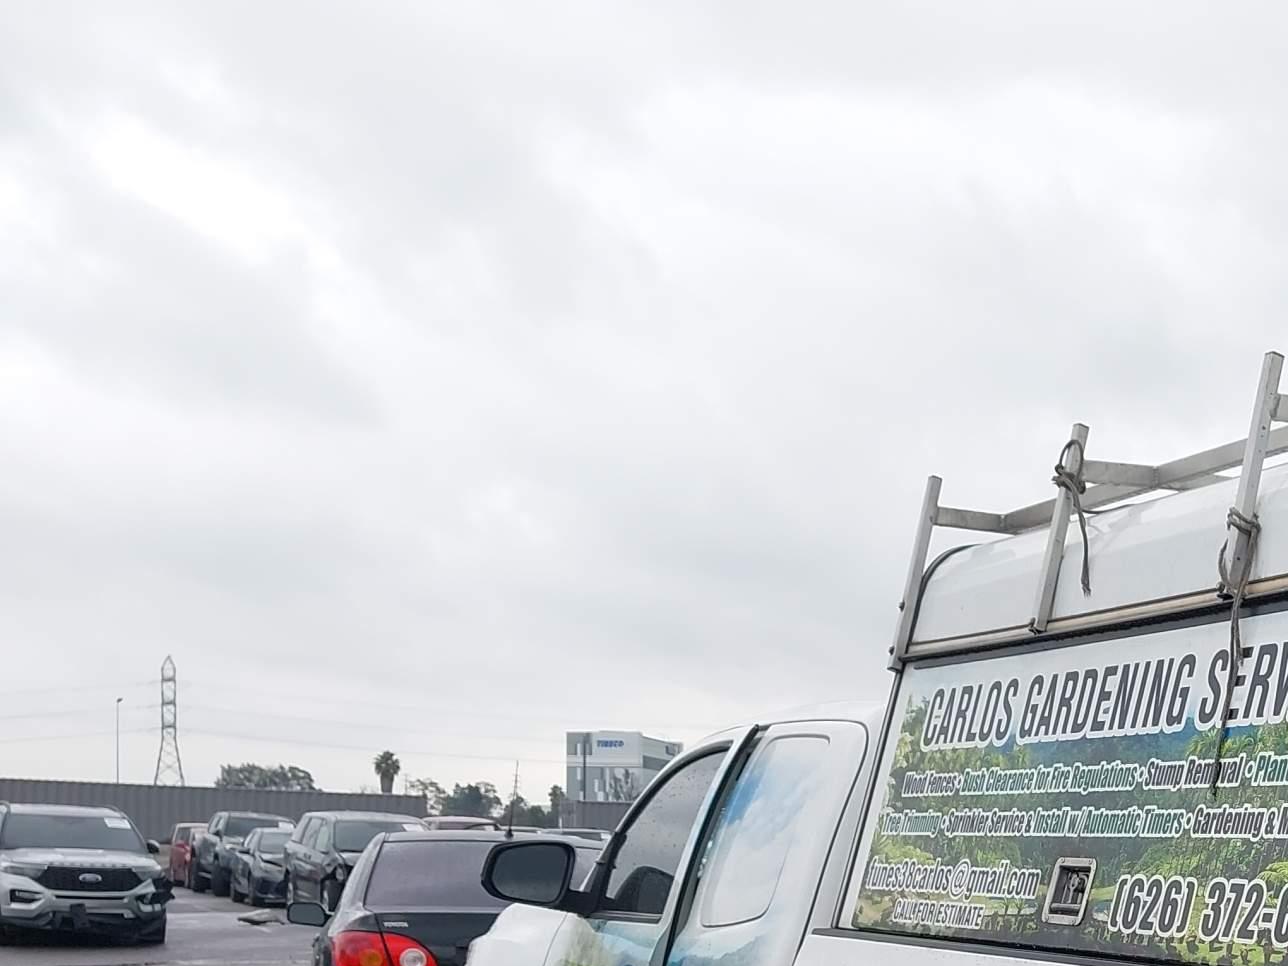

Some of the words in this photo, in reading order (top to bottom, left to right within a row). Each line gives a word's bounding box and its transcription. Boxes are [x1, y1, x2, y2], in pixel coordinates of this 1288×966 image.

[923, 678, 1020, 747] CARLOS
[1019, 653, 1197, 739] GARDENING
[903, 772, 928, 795] Wood
[928, 771, 956, 795] Fences
[961, 769, 986, 793] Bush
[986, 768, 1034, 793] Clearance
[1034, 766, 1051, 791] for
[1050, 764, 1071, 791] Fire
[1071, 761, 1136, 794] Regulations
[1144, 759, 1184, 789] Stump
[901, 810, 942, 837] Trimming
[945, 810, 990, 837] Sprinkler
[990, 810, 1025, 835] Service
[1024, 812, 1033, 834] &
[1033, 808, 1071, 835] Install
[1084, 807, 1142, 835] Automatic
[1141, 806, 1184, 835] Timers
[1192, 805, 1265, 838] Gardening
[1265, 808, 1278, 835] &
[868, 857, 1040, 900] funes38carlos@gmail.com
[893, 900, 915, 921] CALL
[914, 901, 936, 924] FOR
[935, 902, 984, 928] ESTIMATE
[1110, 877, 1196, 933] (626)
